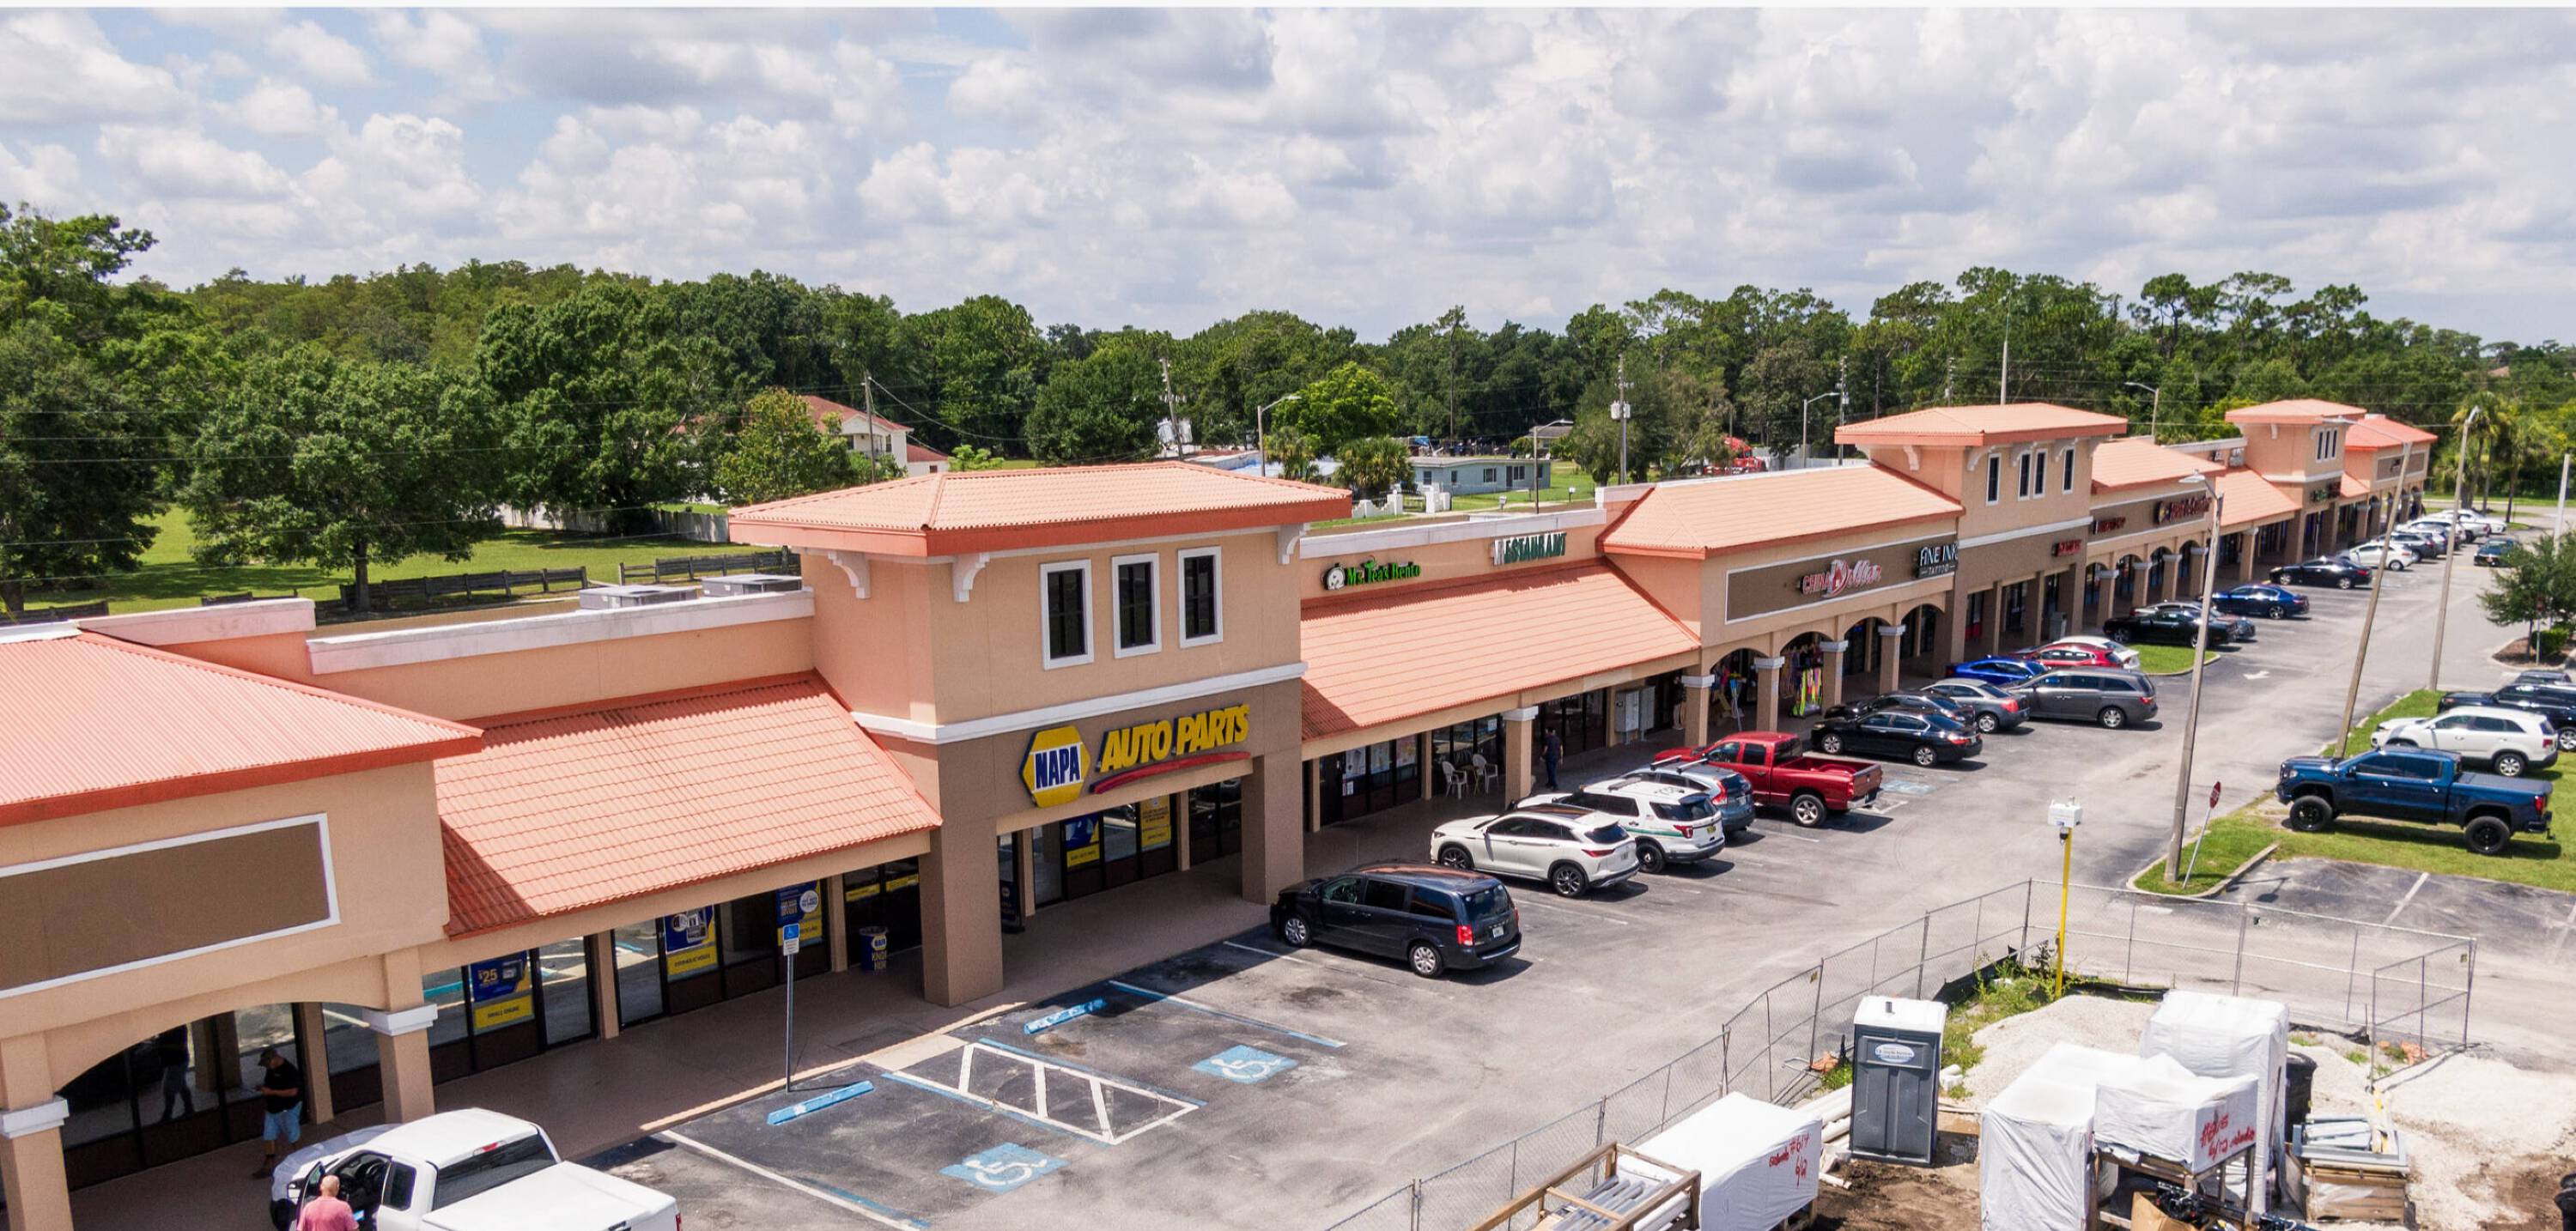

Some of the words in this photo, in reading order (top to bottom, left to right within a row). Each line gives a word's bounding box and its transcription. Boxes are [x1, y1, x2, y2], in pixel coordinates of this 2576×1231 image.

[1919, 546, 1941, 567] FINE
[1942, 543, 1959, 562] INK
[1928, 564, 1950, 575] TATTOO
[1802, 573, 1831, 595] CHINA
[1035, 744, 1081, 790] NAPA
[1099, 719, 1174, 773] AUTO
[1176, 704, 1251, 756] PARTS
